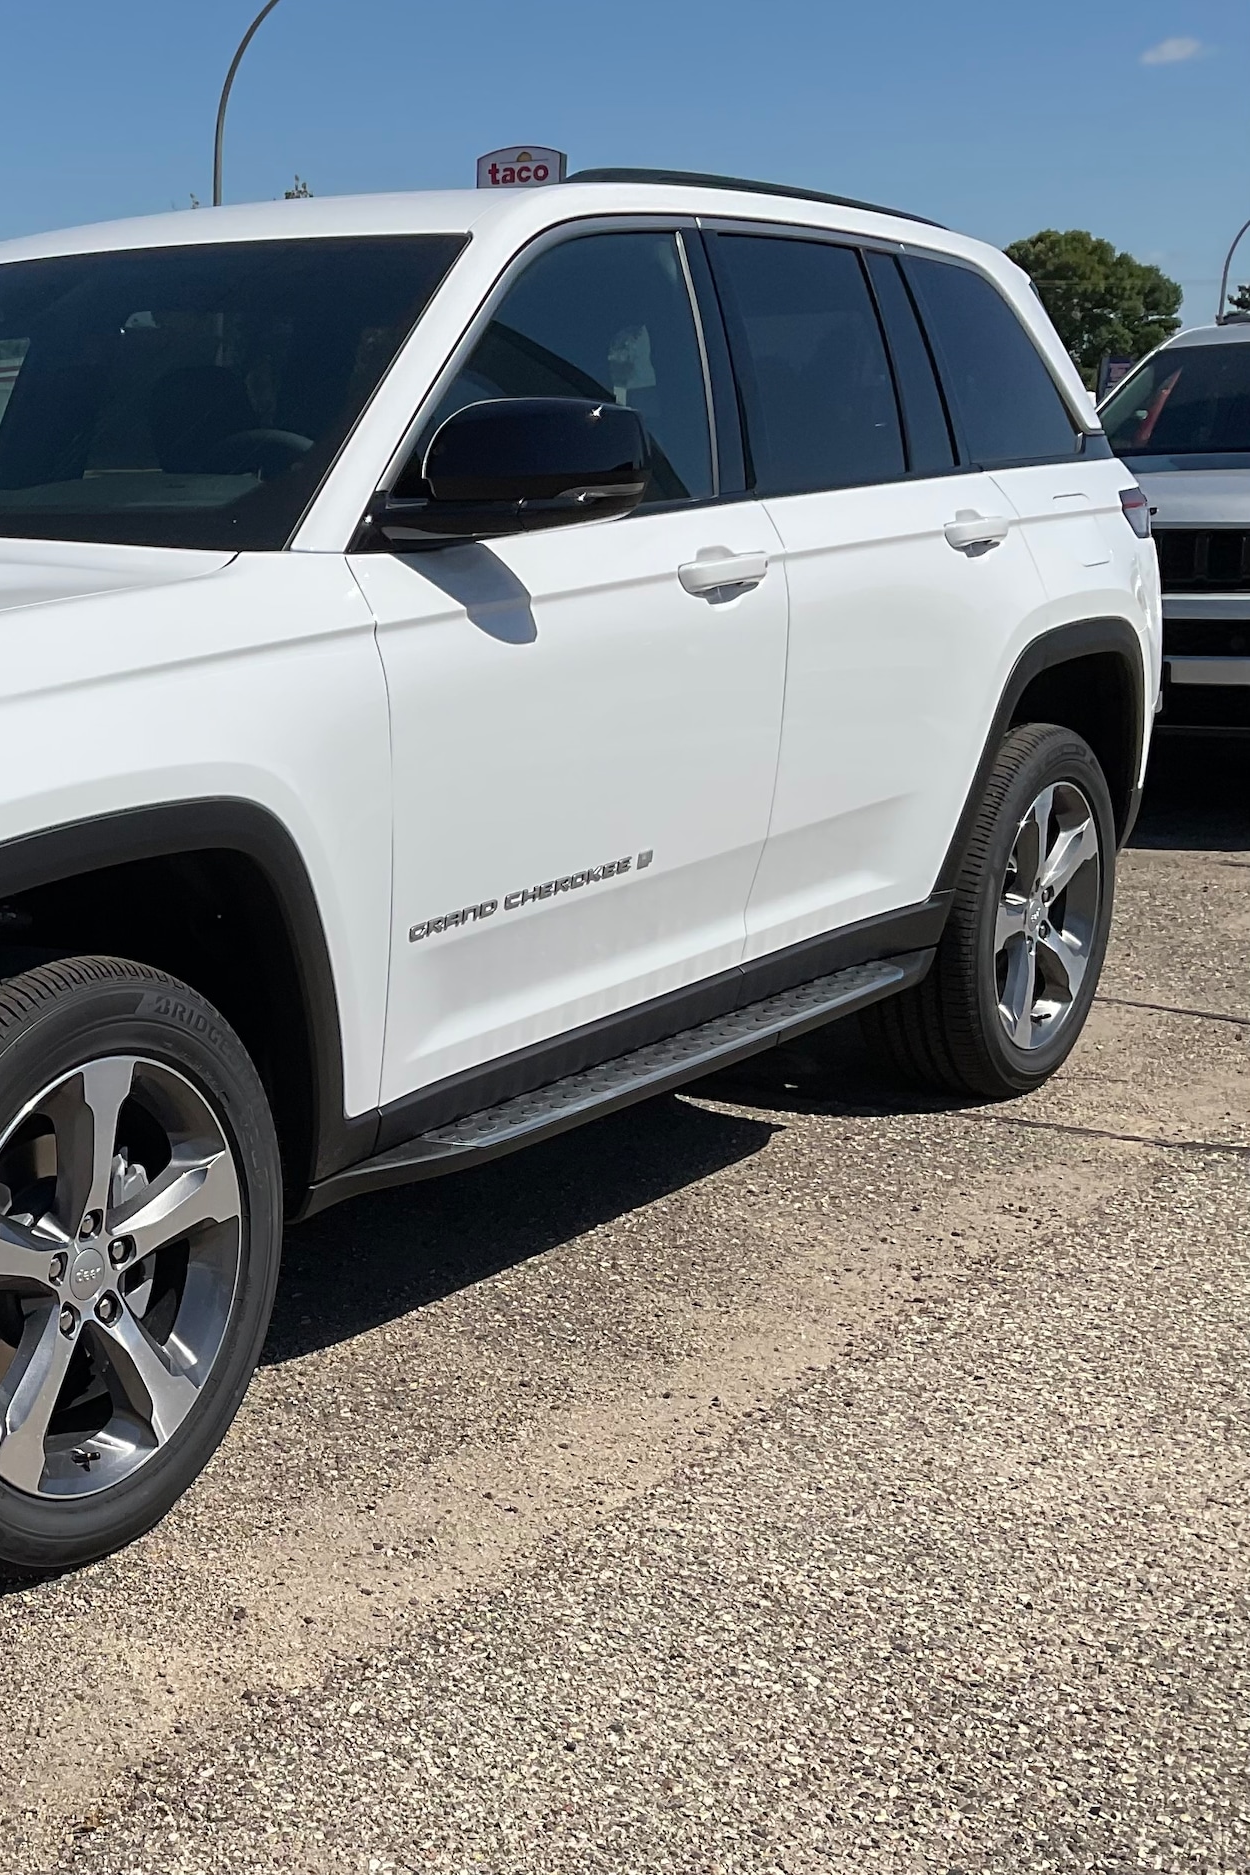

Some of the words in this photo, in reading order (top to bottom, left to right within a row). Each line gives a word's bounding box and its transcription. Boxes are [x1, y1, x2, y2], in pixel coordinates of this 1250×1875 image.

[488, 163, 549, 185] taco
[409, 899, 499, 943] GRAND
[504, 856, 632, 911] CHEROKEE
